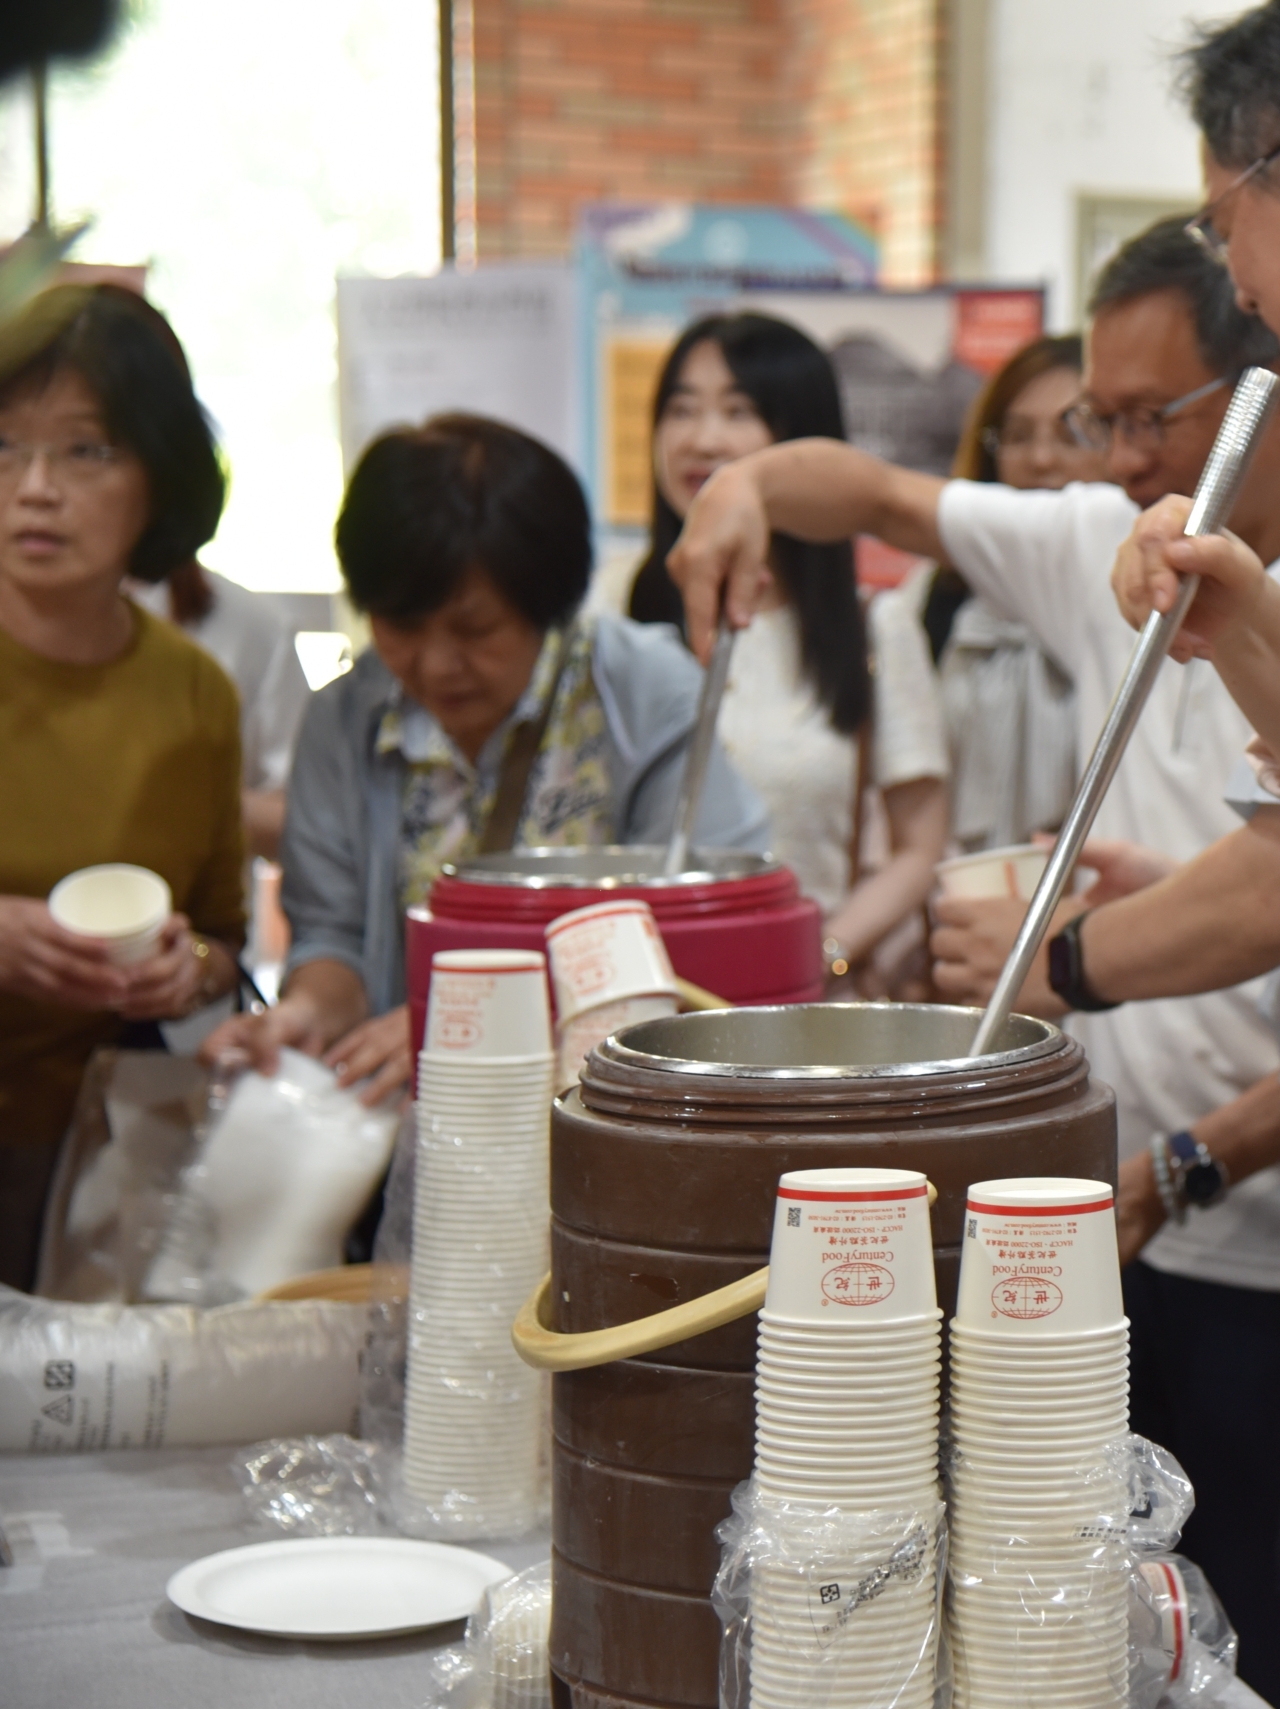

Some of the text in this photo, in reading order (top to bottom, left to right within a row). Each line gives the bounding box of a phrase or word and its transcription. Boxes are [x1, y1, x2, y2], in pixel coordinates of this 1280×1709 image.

[821, 1249, 895, 1263] CenturyFood
[992, 1263, 1062, 1277] CenturyFood
[834, 1276, 883, 1291] 世紀
[1002, 1290, 1050, 1305] 世紀
